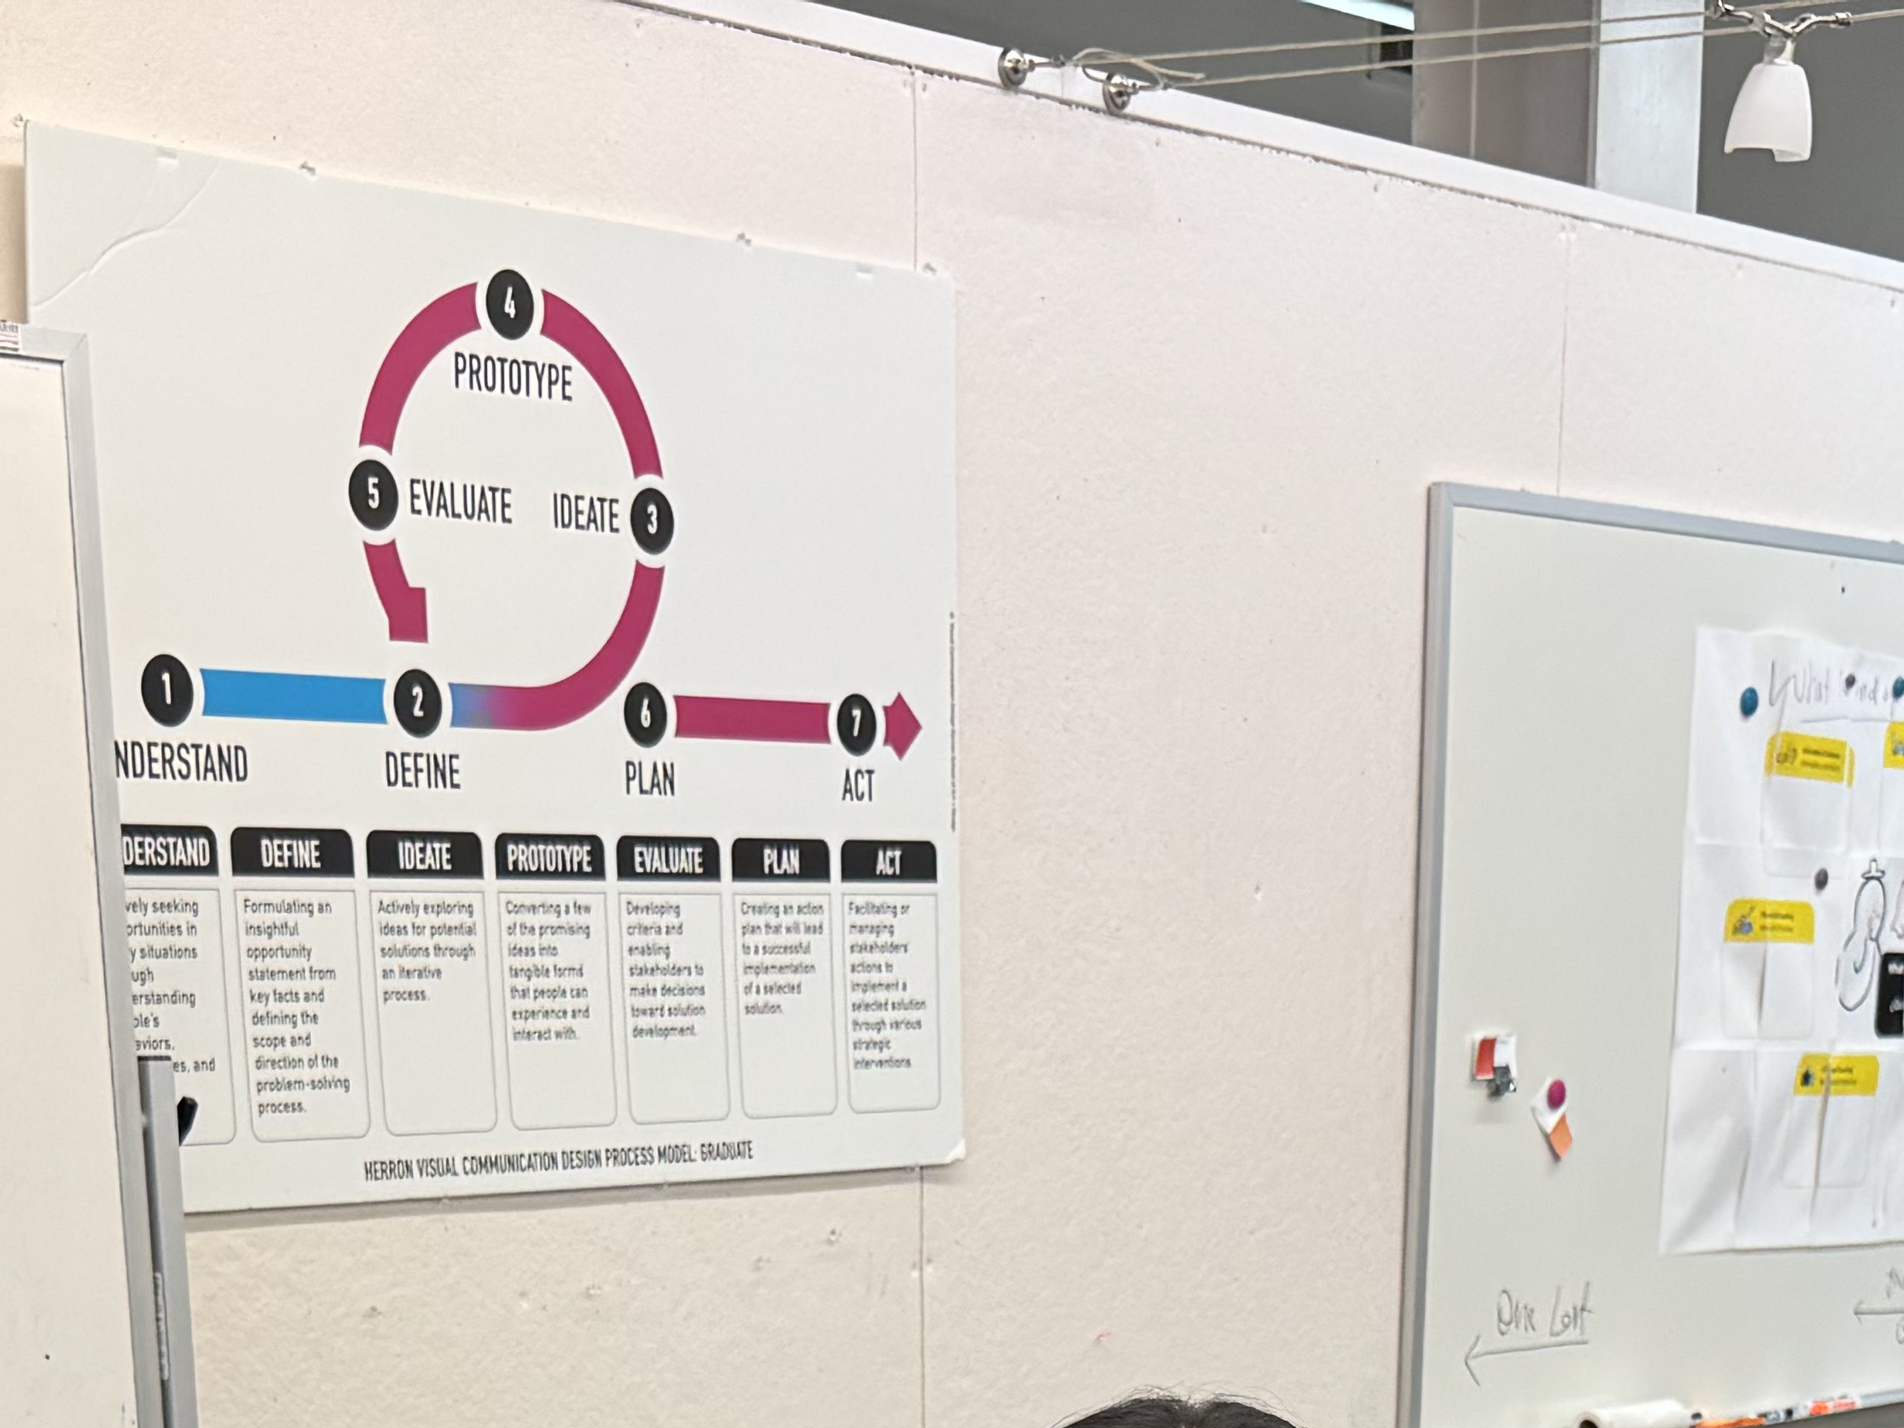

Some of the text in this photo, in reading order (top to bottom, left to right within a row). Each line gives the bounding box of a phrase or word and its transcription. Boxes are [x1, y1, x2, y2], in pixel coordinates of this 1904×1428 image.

[504, 290, 516, 319] 4
[454, 352, 573, 403] PROTOTYPE
[367, 477, 512, 525] 5 EVALUATE
[553, 492, 658, 535] IDEATE 3
[161, 673, 172, 706] 1
[412, 686, 424, 717] 2
[640, 700, 651, 729] 6
[851, 712, 862, 739] 7
[115, 740, 249, 784] NDERSTAND
[385, 752, 461, 791] DEFINE
[625, 762, 676, 797] PLAN
[842, 769, 875, 802] ACT
[122, 836, 210, 866] DERSTAND
[261, 839, 321, 868] DEFINE
[399, 842, 451, 870] IDEATE
[508, 844, 592, 872] PROTOTYPE
[635, 847, 703, 873] EVALUATE
[764, 849, 799, 874] PLAN
[876, 850, 902, 875] ACT
[152, 900, 198, 916] seeking
[244, 900, 332, 916] Formulating an
[378, 900, 473, 918] Actively exploring
[506, 901, 591, 918] Converting a few
[626, 902, 680, 918] Developing
[741, 902, 823, 917] Creating an action
[849, 902, 909, 917] Facilitating or
[186, 922, 197, 936] in
[246, 922, 299, 938] insightful
[379, 922, 476, 939] ideas for potential
[507, 922, 590, 939] of the promising
[627, 923, 683, 936] criteria and
[742, 922, 823, 937] plan that will lead
[849, 923, 894, 937] managing
[140, 945, 197, 959] situations
[247, 945, 312, 961] opportunity
[381, 944, 476, 961] solutions through
[508, 944, 558, 957] ideas into
[628, 944, 670, 958] enabling
[742, 942, 811, 955] to a successful
[249, 967, 336, 981] statement from
[382, 966, 442, 980] an iterative
[509, 964, 583, 981] tangible forms
[629, 964, 703, 977] stakeholders to
[743, 962, 815, 976] implementation
[511, 987, 588, 1004] that people can
[630, 984, 705, 997] make decisions
[744, 982, 801, 995] of a selected
[250, 989, 324, 1006] key facts and
[512, 1007, 589, 1022] experience and
[631, 1004, 705, 1017] toward solution
[253, 1011, 318, 1028] defining the
[253, 1034, 311, 1051] scope and
[513, 1028, 551, 1041] interact
[194, 1058, 215, 1072] and
[255, 1056, 338, 1070] direction of the
[257, 1078, 350, 1094] problem-solving
[258, 1101, 306, 1115] process.
[364, 1159, 414, 1182] HERRON
[417, 1156, 459, 1178] VISUAL
[463, 1151, 559, 1176] COMMUNICATION
[561, 1150, 602, 1170] DESIGN
[605, 1147, 654, 1168] PROCESS
[700, 1140, 753, 1162] GRADUATE
